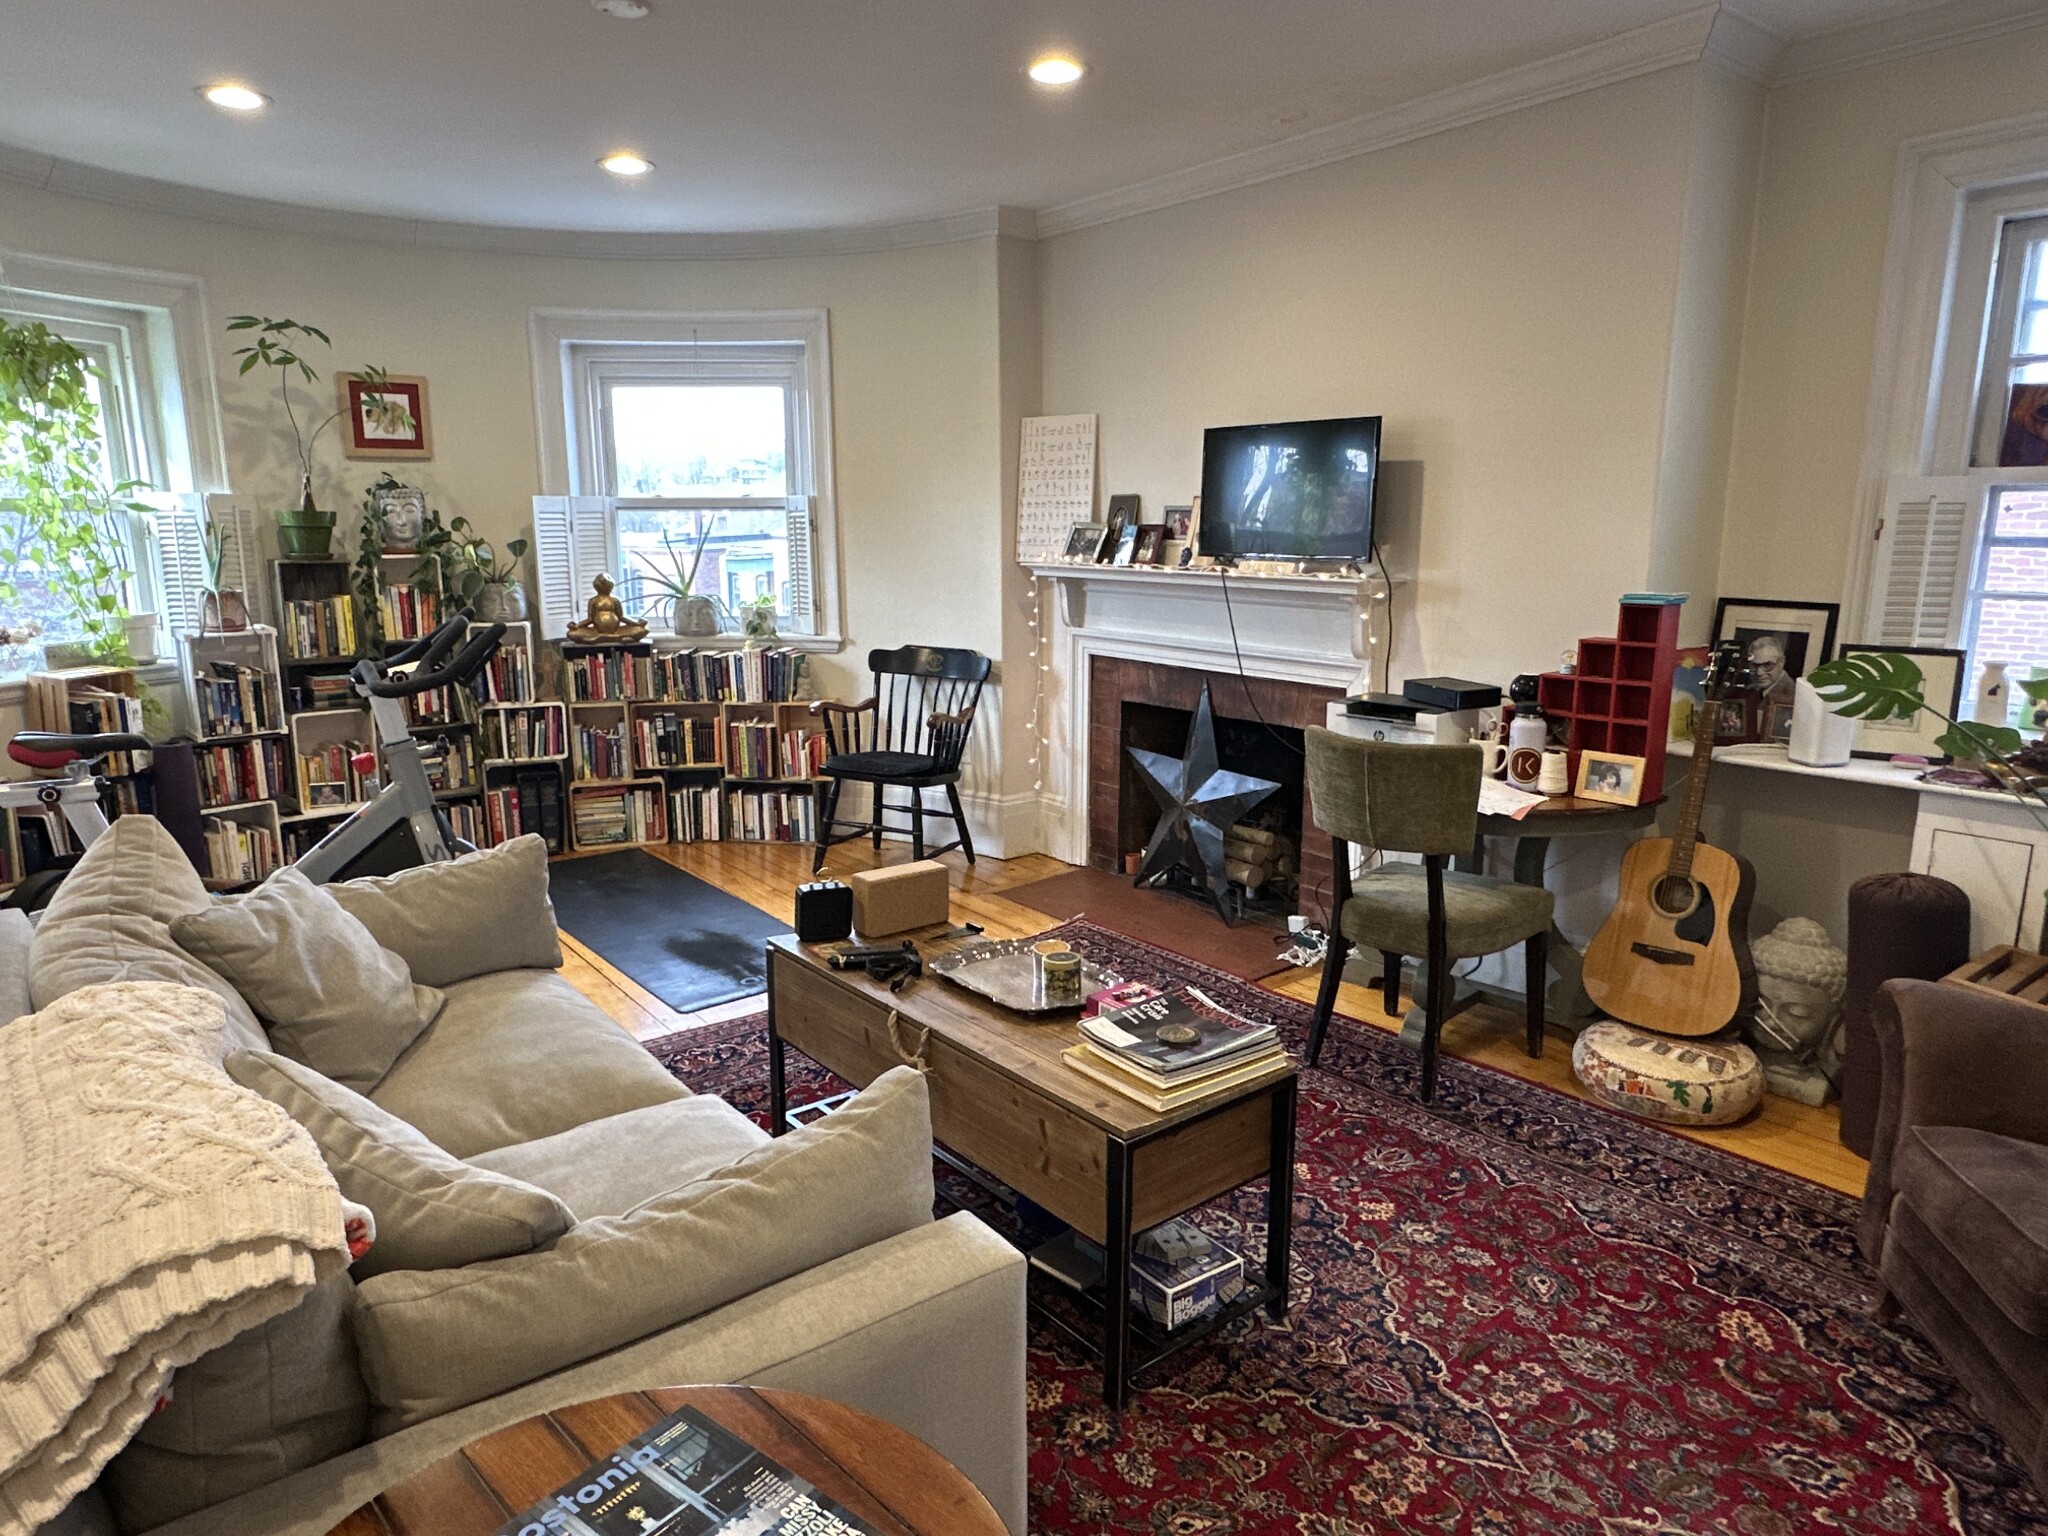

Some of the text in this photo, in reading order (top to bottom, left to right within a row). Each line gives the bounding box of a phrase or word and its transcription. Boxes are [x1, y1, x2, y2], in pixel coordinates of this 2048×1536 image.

[500, 1445, 660, 1536] ostonia
[780, 1494, 812, 1519] CAN
[778, 1501, 822, 1536] MISSY
